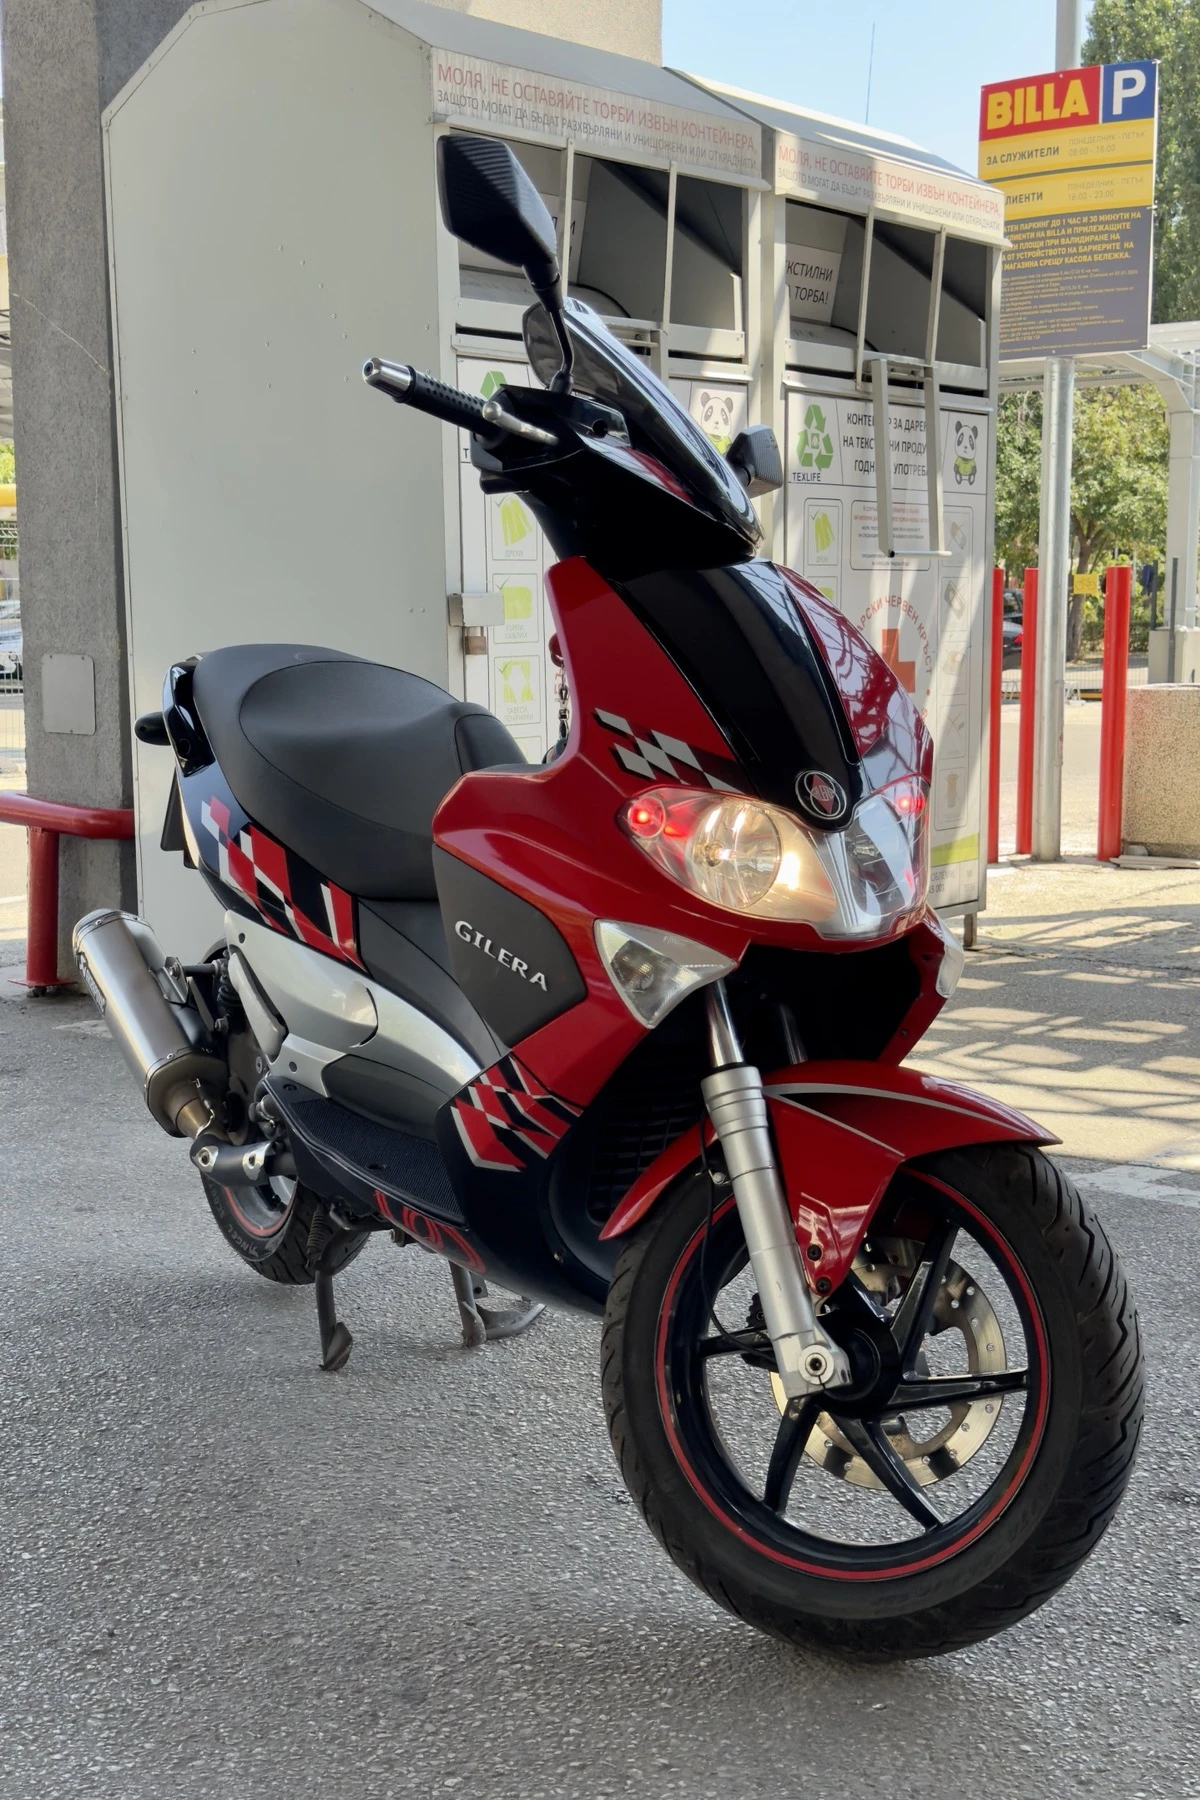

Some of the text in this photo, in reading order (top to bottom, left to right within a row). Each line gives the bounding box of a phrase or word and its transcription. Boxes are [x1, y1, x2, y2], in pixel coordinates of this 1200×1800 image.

[438, 63, 757, 155] МОЛЯ, НЕ ОСТАВЯЙТЕ ТОРБИ ИЗВЪН КОНТЕЙНЕРА,
[986, 69, 1147, 130] BILLA P
[437, 90, 478, 110] ЗАЩОТО
[482, 101, 513, 117] МОГАТ
[515, 107, 528, 121] ДА
[531, 111, 559, 127] БЪДАТ
[562, 117, 622, 140] РАЗХВЪРЛЯНИ
[624, 133, 631, 142] И
[633, 134, 687, 153] УНИЩОЖЕНИ
[689, 146, 706, 158] ИЛИ
[1068, 134, 1116, 146] ПОНЕДЕЛНИК
[1122, 131, 1146, 140] ПЕТЪК
[986, 146, 1060, 166] ЗА СЛУЖИТЕЛИ
[778, 168, 807, 184] ЗАЩОТО
[808, 175, 829, 188] МОГАТ
[831, 181, 840, 192] ДА
[842, 183, 862, 196] БЪДАТ
[779, 146, 1001, 218] МОЛЯ, НЕ ОСТАВЯЙТЕ ТОРБИ ИЗВЪН КОНТЕЙНЕРА,
[1067, 179, 1115, 190] ПОНЕДЕЛНИК
[1121, 176, 1144, 185] ПЕТЪК
[1005, 192, 1043, 206] ЛИЕНТИ
[1020, 220, 1050, 231] ПАРКИНГ
[1051, 218, 1061, 228] ДО
[1067, 217, 1082, 225] ЧАС
[1089, 215, 1098, 223] 30
[1099, 212, 1130, 223] МИНУТИ
[1131, 211, 1142, 219] НА
[1008, 231, 1035, 242] ЛИЕНТИ
[1036, 230, 1045, 238] НА
[1046, 228, 1066, 237] BILLA
[1074, 222, 1131, 235] ПРИЛЕЖАЩИТЕ
[1019, 240, 1044, 250] ПЛОЩИ
[1045, 238, 1059, 246] ПРИ
[1060, 234, 1108, 245] ВАЛИДИРАНЕ
[1110, 233, 1120, 241] НА
[1016, 246, 1067, 260] УСТРОЙСТВОТО
[1067, 246, 1077, 254] НА
[1078, 242, 1120, 253] БАРИЕРИТЕ
[1123, 241, 1134, 249] НА
[786, 260, 833, 282] КСТИЛНИ
[1004, 252, 1131, 271] МАГАЗИНА СРЕЩУ КАСОВА БЕЛЕЖКА.
[795, 285, 829, 305] ТОРБА!
[893, 417, 903, 430] ЗА
[843, 435, 854, 448] НА
[901, 441, 927, 456] ПРОДУ
[792, 472, 821, 483] TEXLIFE
[854, 459, 928, 477] ГОДН УПОТРЕБ
[884, 594, 919, 624] ЧЕРВЕН
[916, 622, 932, 673] КРЪСТ
[455, 920, 548, 992] GILERA
[228, 1224, 259, 1258] ANGEL
